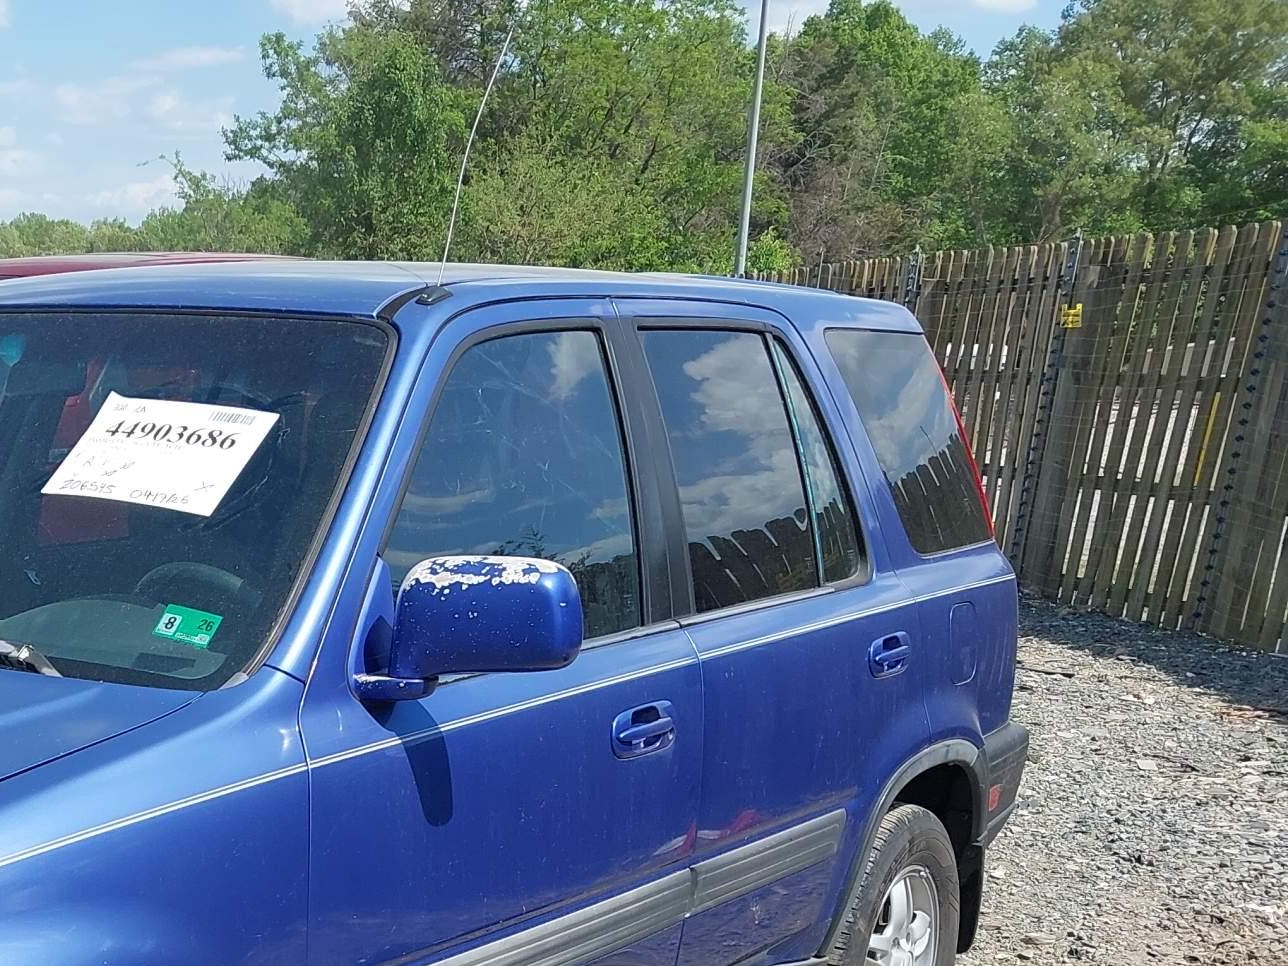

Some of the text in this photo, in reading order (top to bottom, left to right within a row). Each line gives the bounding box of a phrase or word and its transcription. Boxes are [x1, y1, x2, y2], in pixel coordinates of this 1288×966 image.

[105, 420, 240, 450] 44903686
[165, 616, 177, 630] 8
[197, 618, 215, 632] 26
